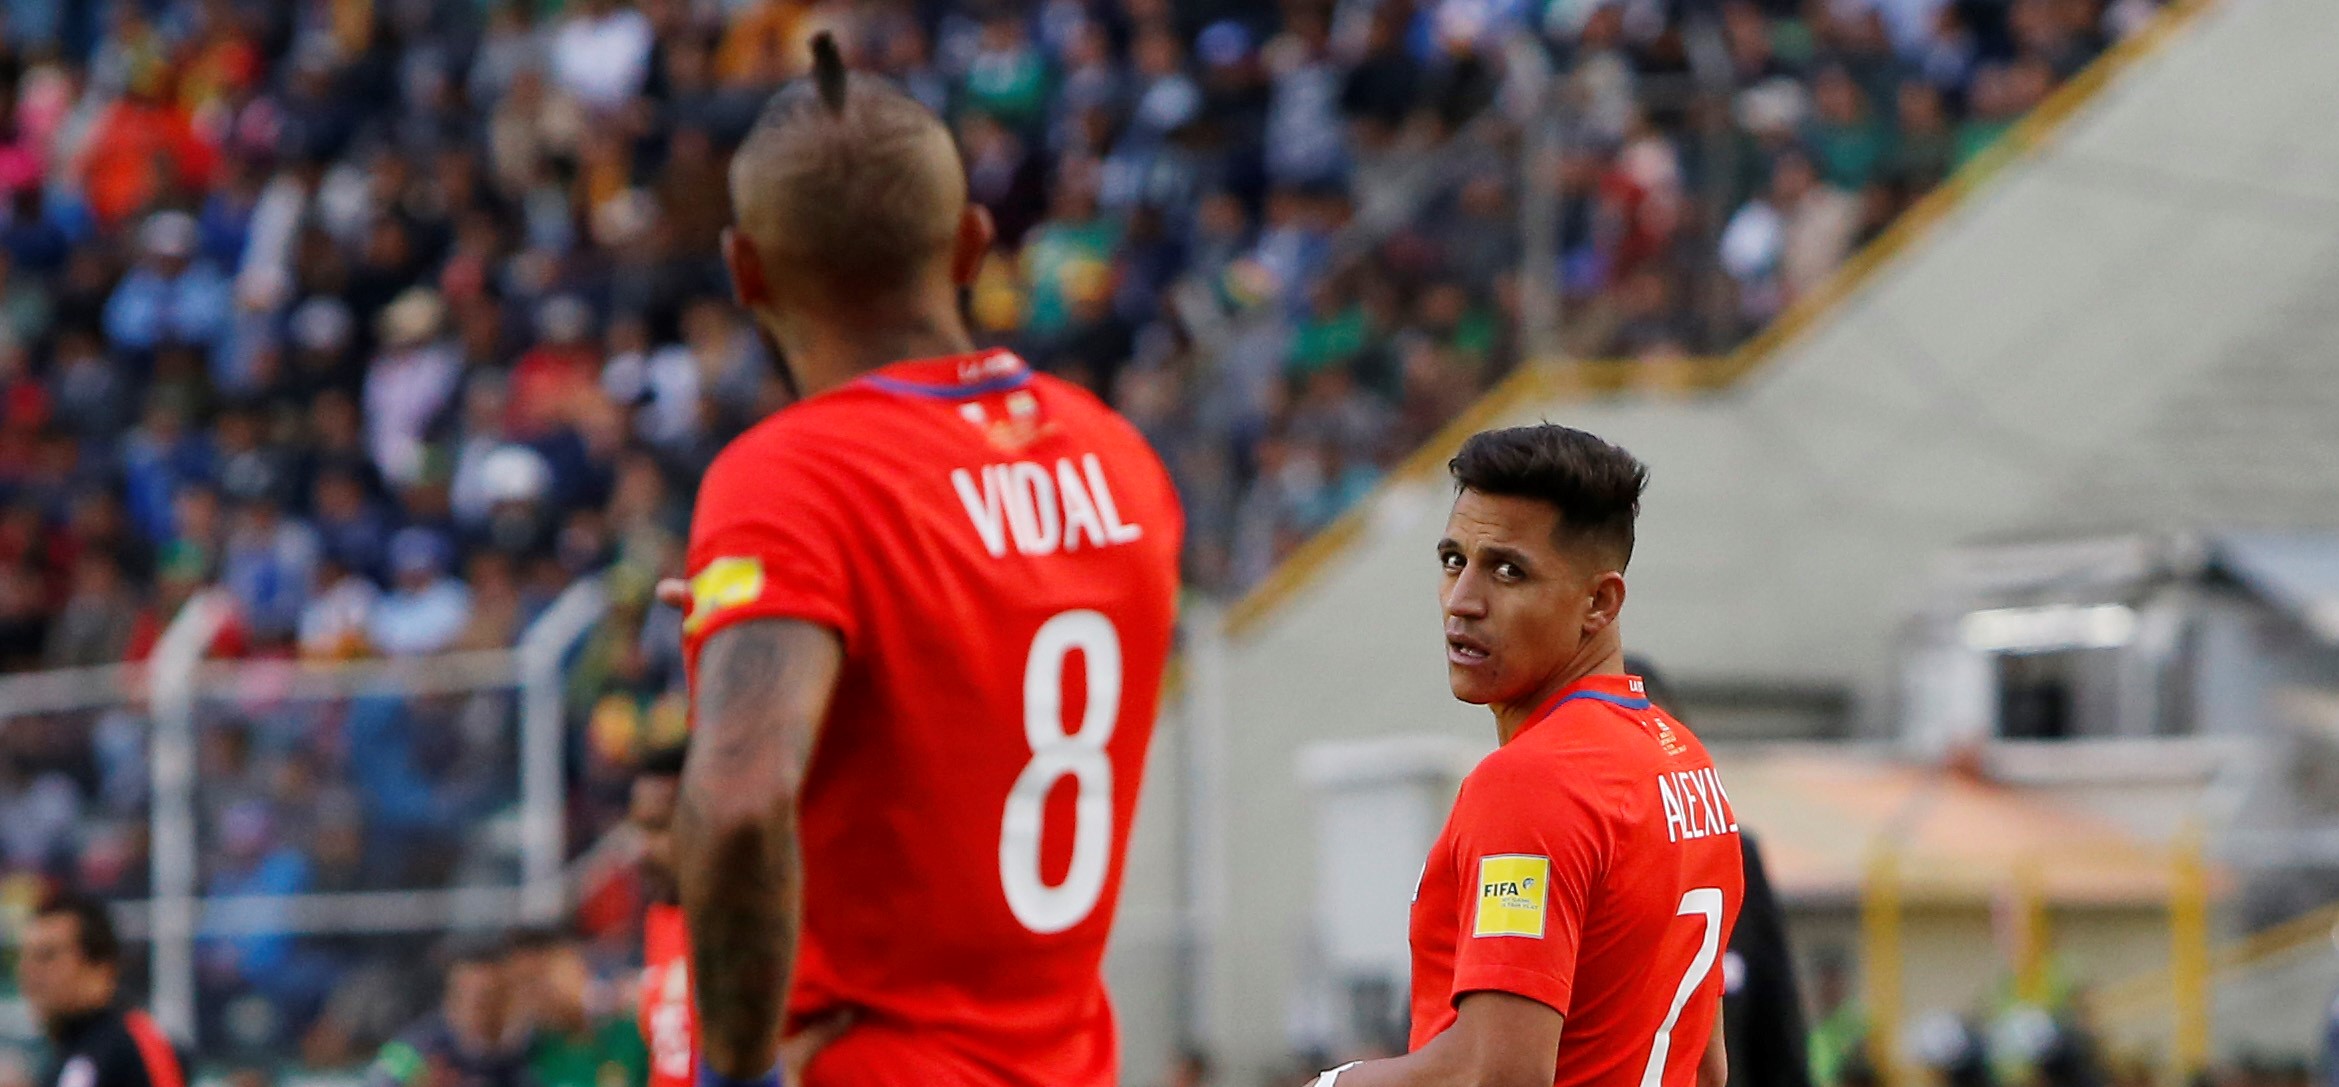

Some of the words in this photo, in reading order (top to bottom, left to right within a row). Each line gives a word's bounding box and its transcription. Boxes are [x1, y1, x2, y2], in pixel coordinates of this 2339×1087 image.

[951, 453, 1142, 557] VIDAL
[998, 608, 1122, 934] 8
[1484, 882, 1518, 897] FIFA
[1641, 887, 1723, 1087] 7
